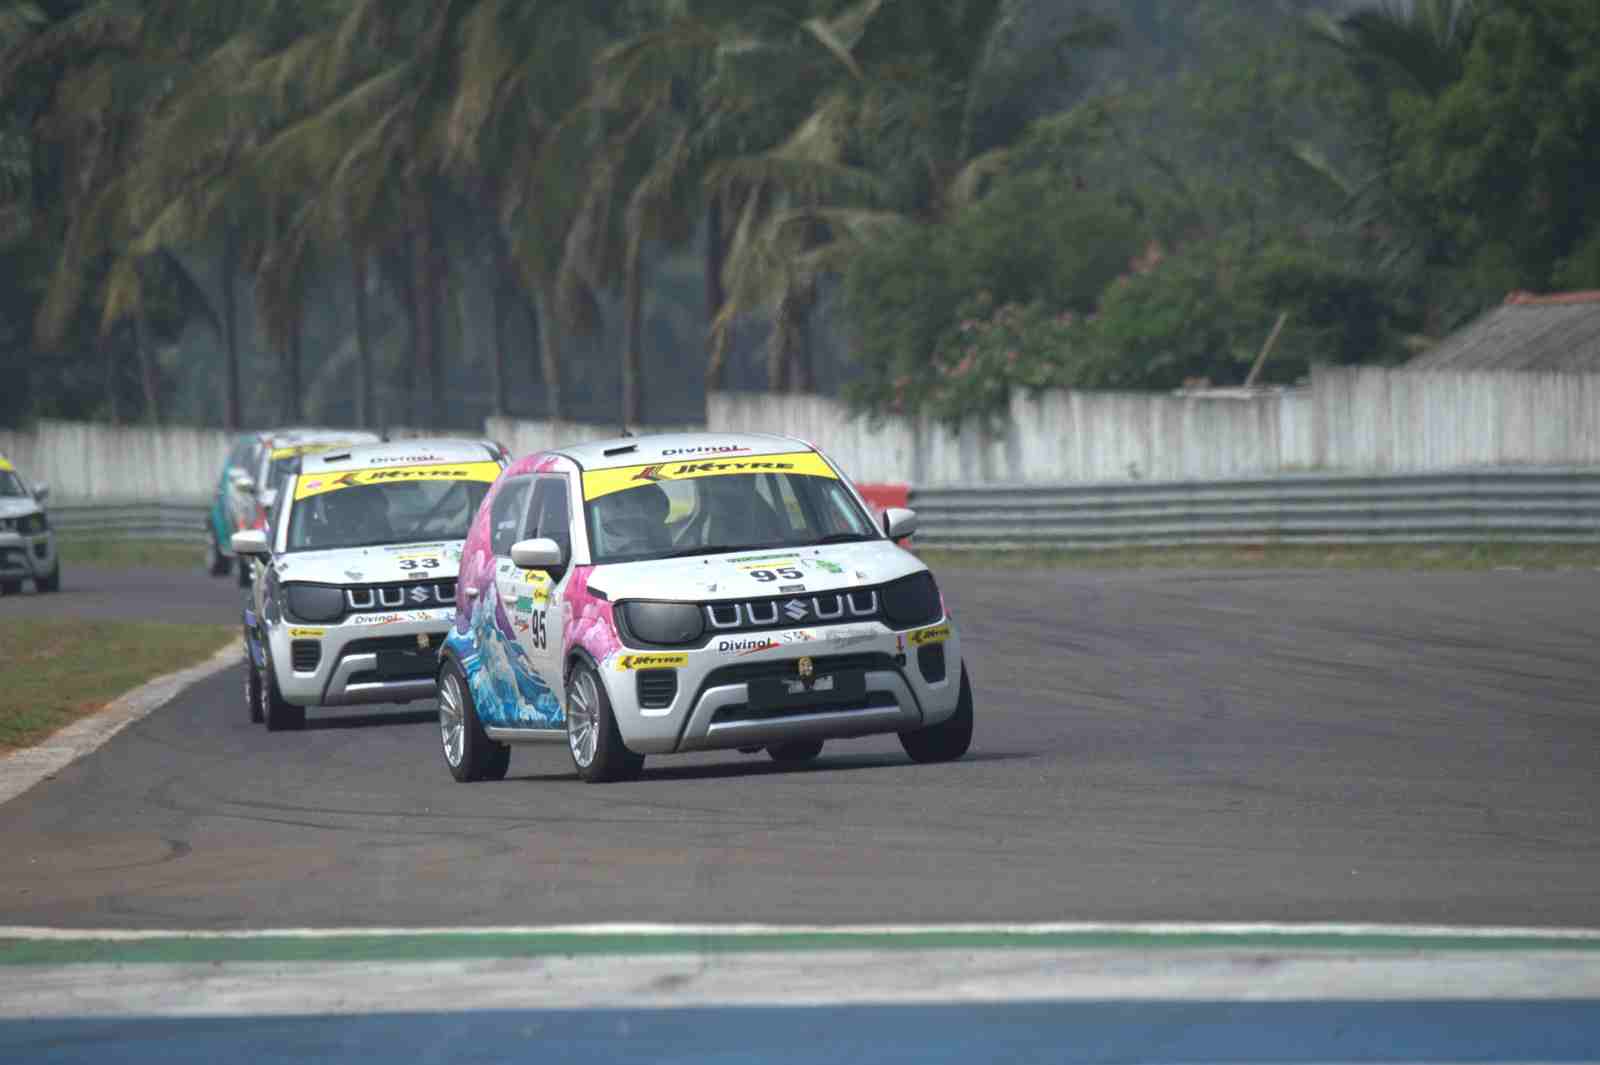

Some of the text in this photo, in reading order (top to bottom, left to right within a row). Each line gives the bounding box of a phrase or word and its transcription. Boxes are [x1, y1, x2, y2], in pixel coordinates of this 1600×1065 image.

[662, 444, 738, 456] Divinol
[399, 558, 440, 570] 33
[750, 567, 804, 582] 95
[532, 608, 547, 650] 95
[719, 637, 772, 652] Divinol
